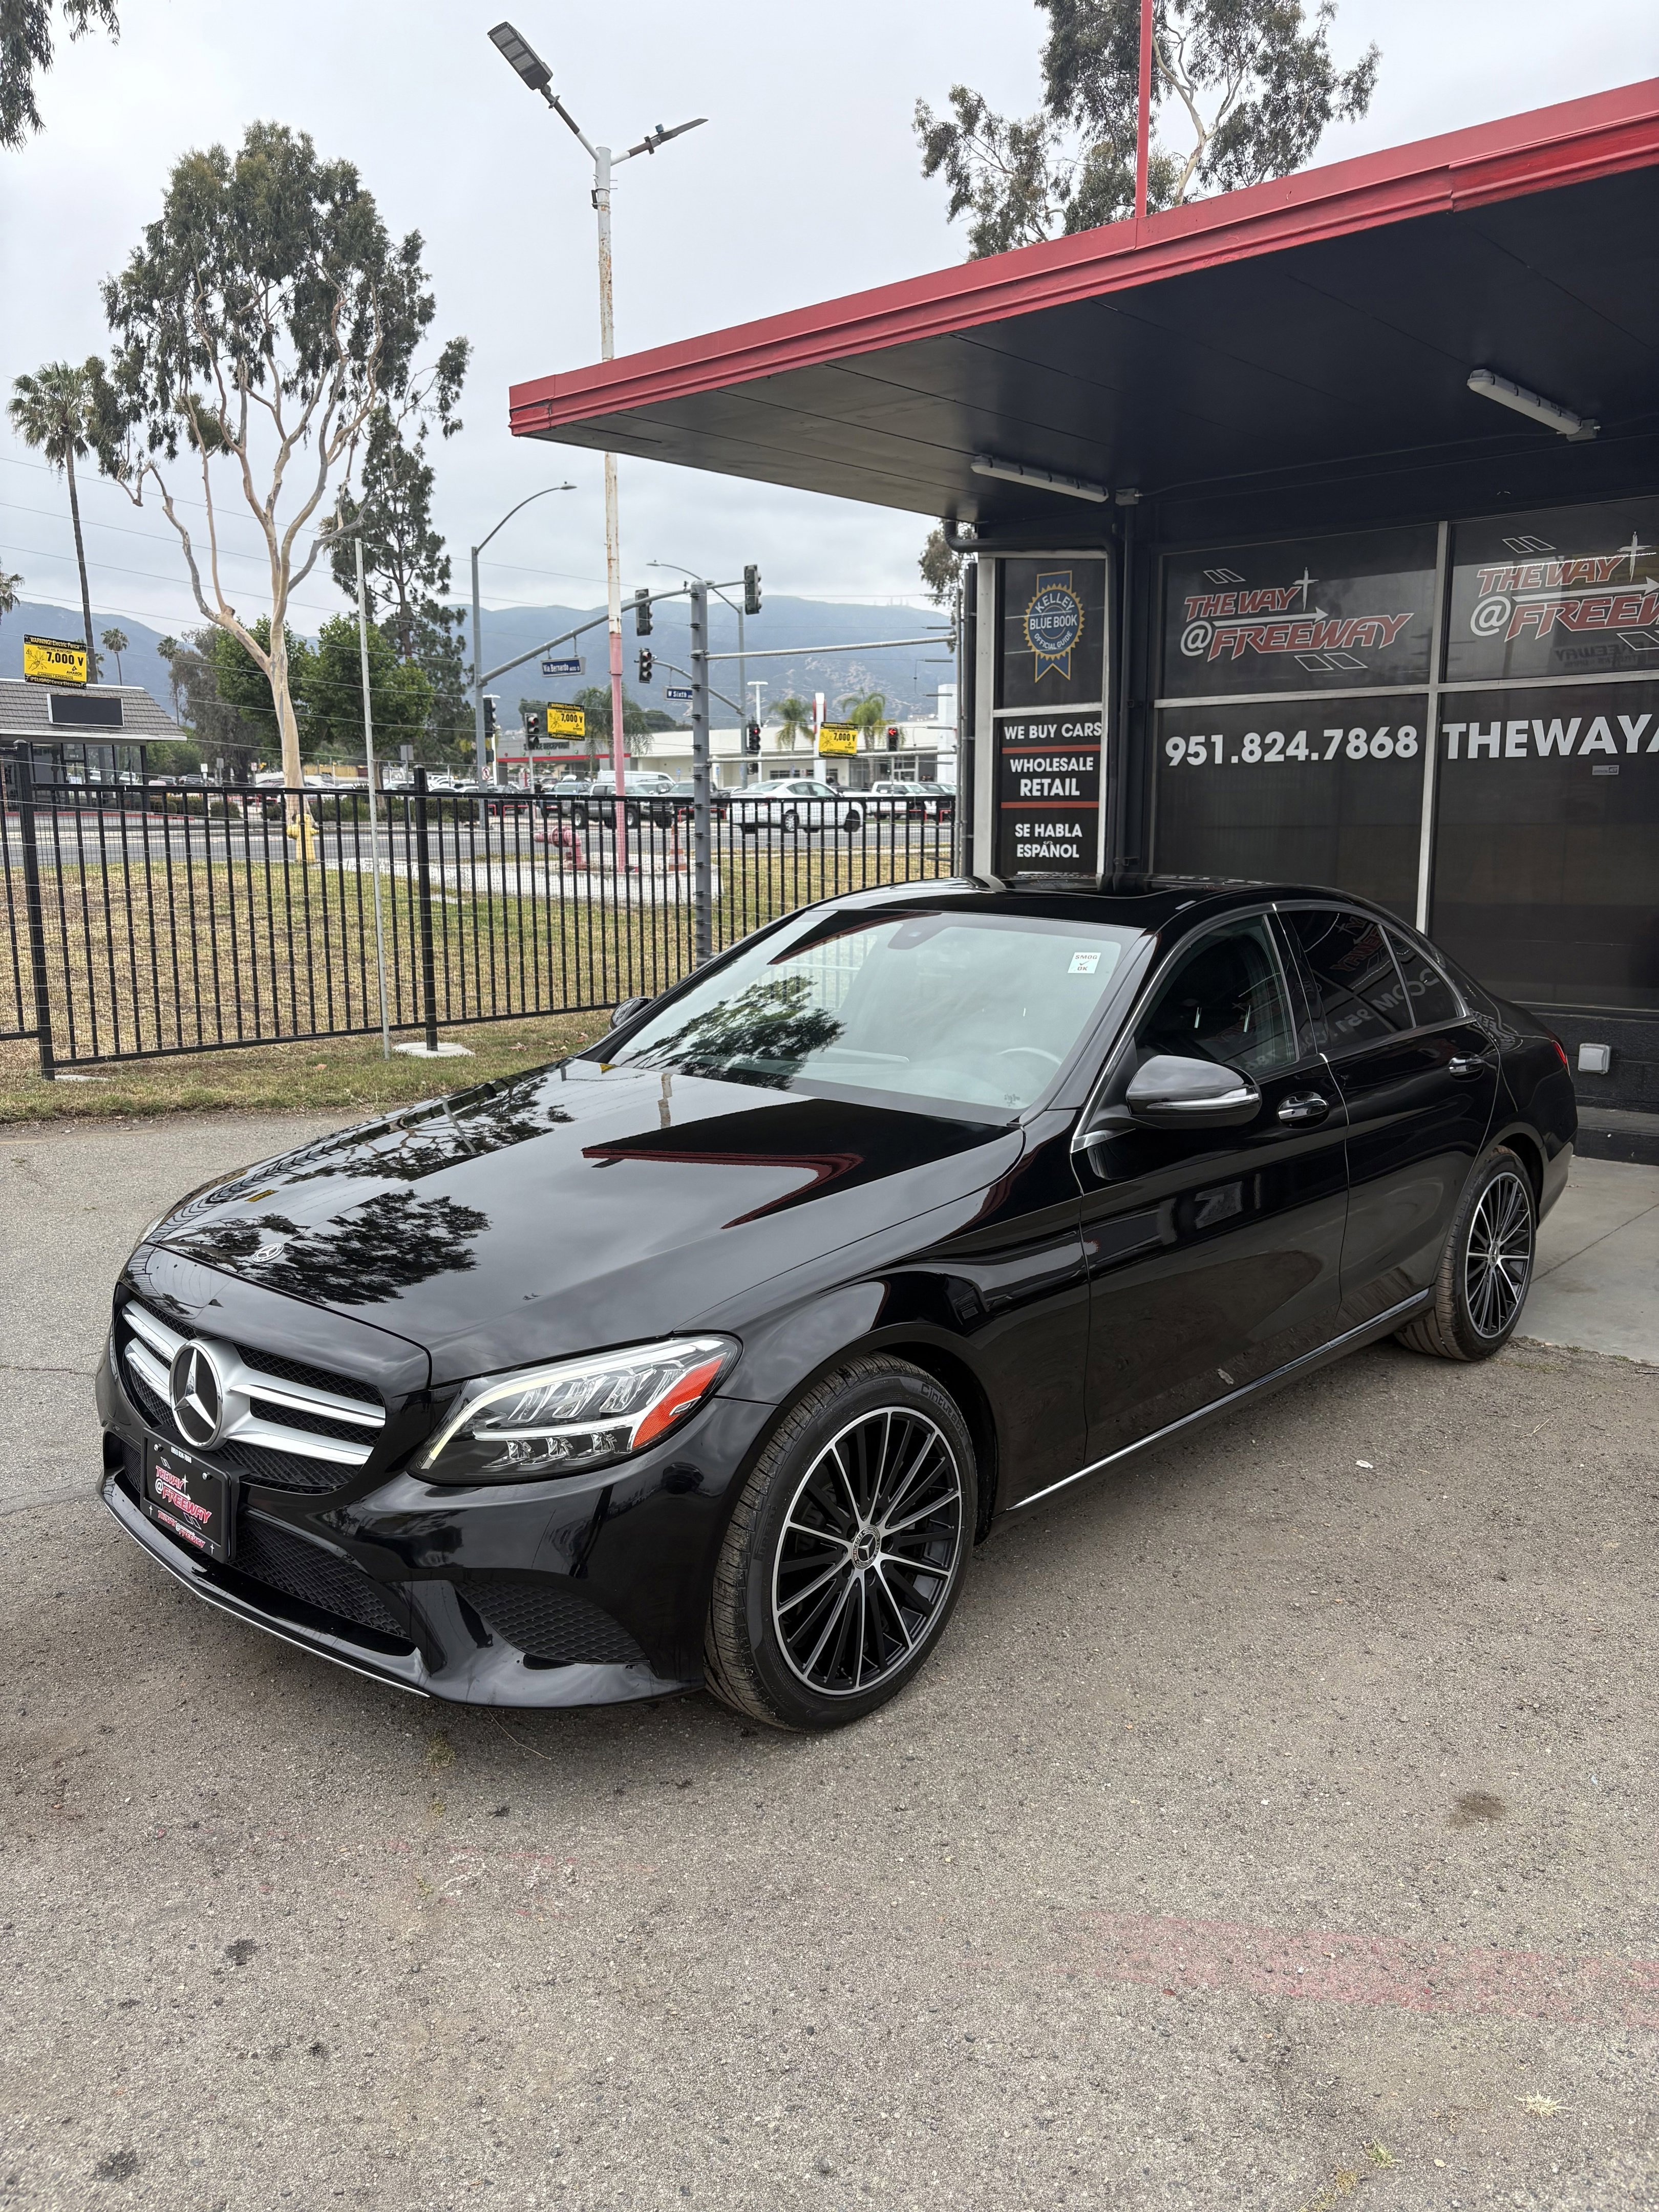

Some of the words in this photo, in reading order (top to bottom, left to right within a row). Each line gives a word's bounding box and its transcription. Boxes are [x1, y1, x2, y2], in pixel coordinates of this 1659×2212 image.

[1035, 592, 1075, 613] KELLEY
[1030, 618, 1052, 630] BLUE
[1053, 614, 1078, 628] BOOK
[1034, 633, 1057, 650] OFFICIAL
[1057, 630, 1072, 648] GUIDE
[47, 651, 74, 665] 7,000
[78, 657, 83, 666] V
[561, 714, 578, 722] 7,000
[834, 733, 850, 741] 7,000
[1004, 726, 1025, 739] WE
[1029, 724, 1057, 738] BUY
[1061, 722, 1102, 737] CARS
[1165, 726, 1418, 766] 951.824.7868
[1010, 757, 1094, 772] WHOLESALE
[1020, 778, 1080, 796] RETAIL
[1015, 824, 1030, 837] SE
[1034, 824, 1082, 837] HABLA
[1017, 840, 1079, 858] ESPAÑOL
